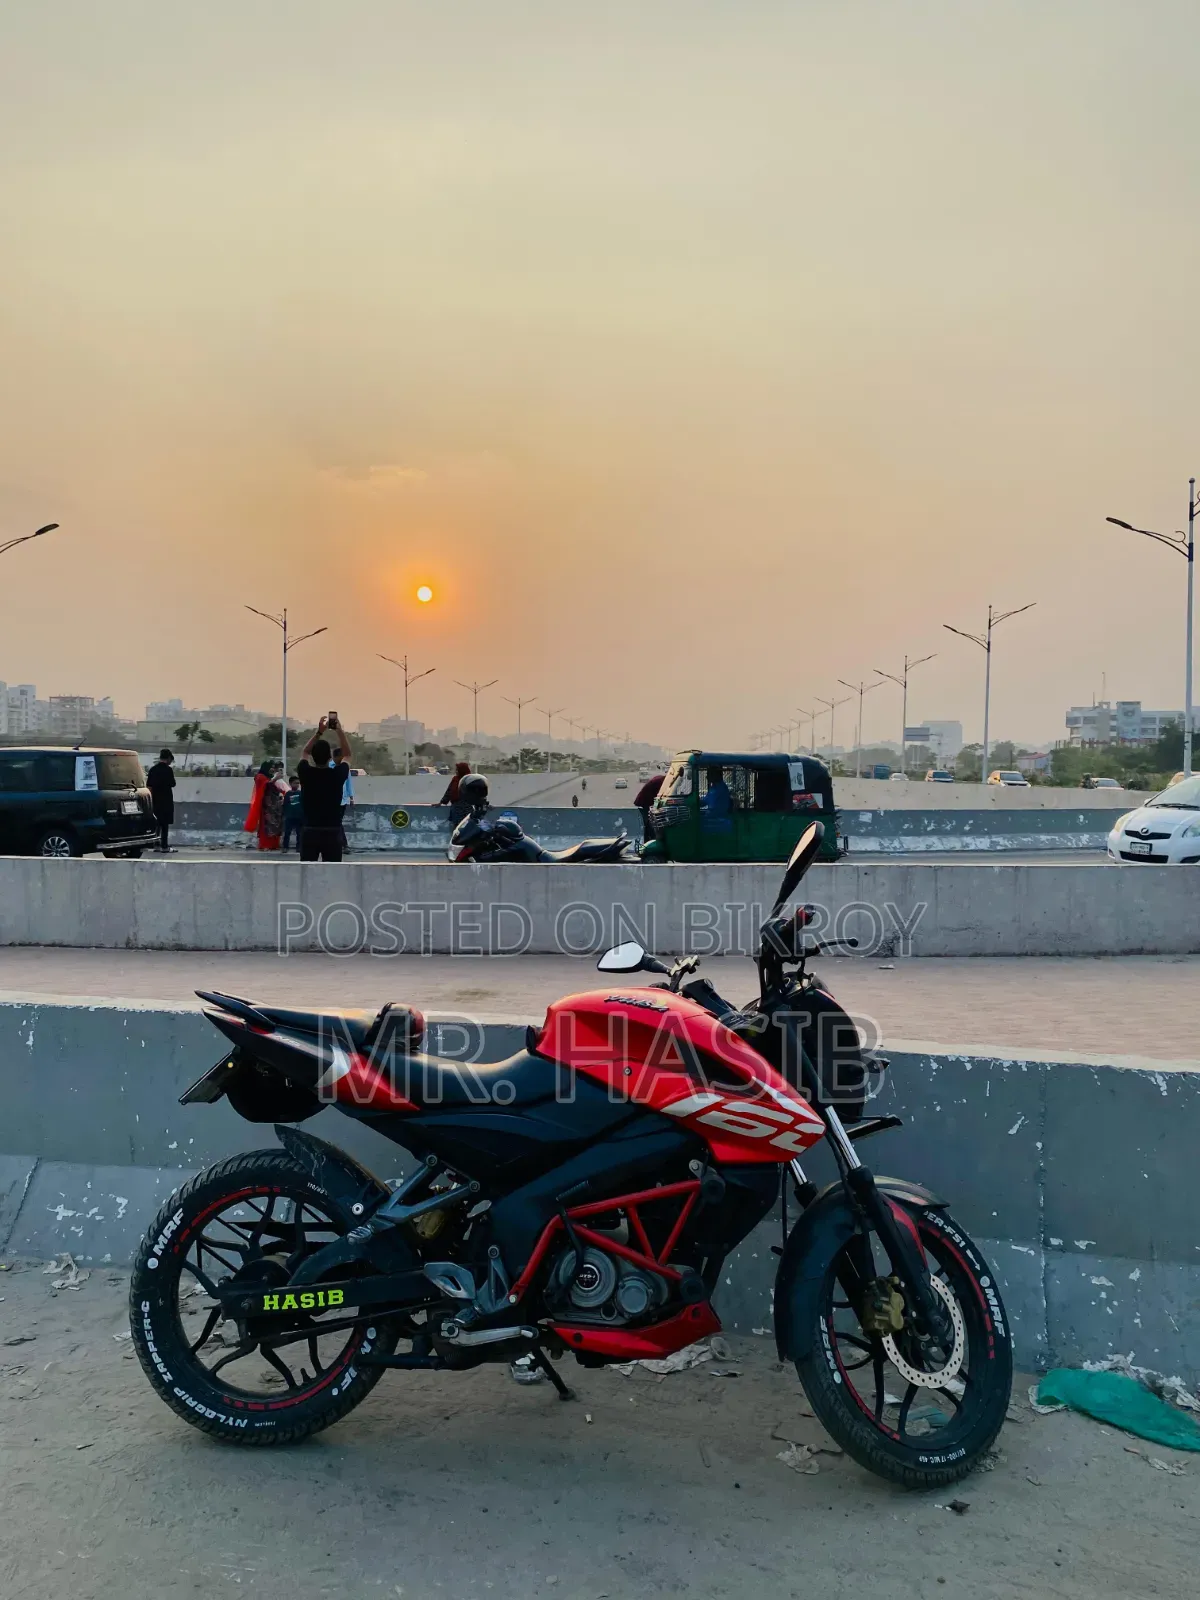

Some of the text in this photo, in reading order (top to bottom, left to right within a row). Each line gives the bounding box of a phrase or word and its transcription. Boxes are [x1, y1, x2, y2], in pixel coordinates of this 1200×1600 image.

[154, 1207, 185, 1259] MRF
[923, 1210, 966, 1248] ER-FS1
[263, 1288, 344, 1311] HASIB
[984, 1288, 1006, 1337] MRF
[819, 1315, 837, 1370] MRF
